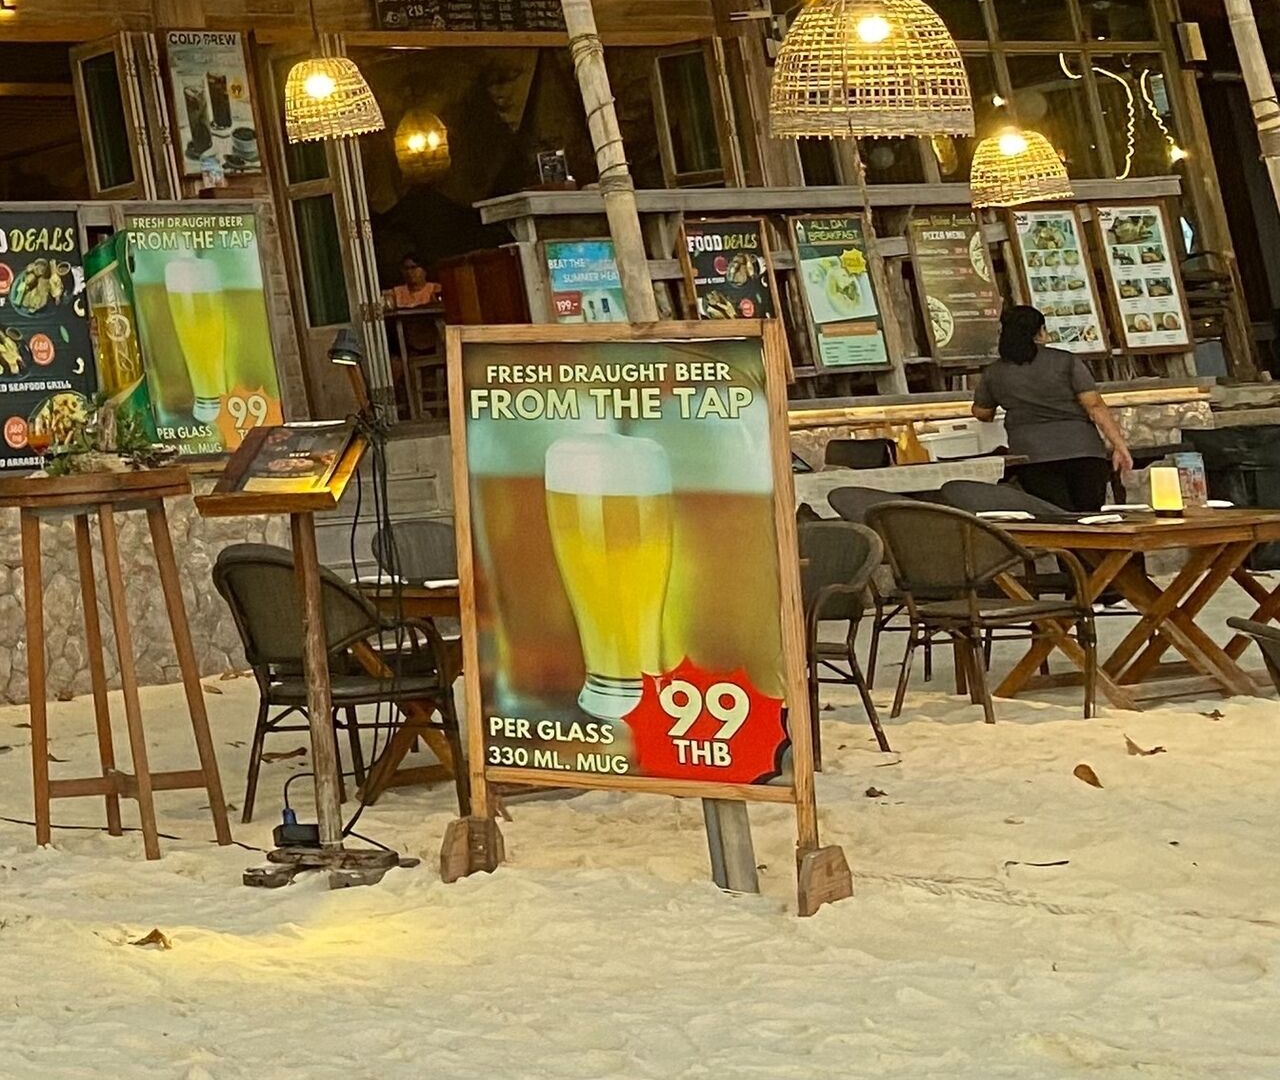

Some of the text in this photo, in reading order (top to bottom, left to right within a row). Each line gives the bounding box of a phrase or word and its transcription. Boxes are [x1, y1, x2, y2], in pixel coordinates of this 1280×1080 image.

[169, 33, 237, 46] COLD BREW
[132, 216, 243, 228] FRESH DRAUGHT BEER
[9, 227, 75, 252] DEALS
[127, 230, 255, 251] FROM THE TAP
[687, 234, 757, 252] FOOD DEALS
[808, 230, 858, 241] BREAKFAST
[548, 258, 567, 269] BEAT
[562, 272, 599, 283] SUMMER
[486, 363, 731, 384] FRESH DRAUGHT BEER
[8, 382, 45, 392] SEAFOOD
[46, 380, 72, 390] GRILL
[228, 395, 268, 428] 99
[470, 387, 754, 420] FROM THE TAP
[157, 425, 213, 440] PER GLASS
[199, 442, 223, 453] MUG
[659, 678, 751, 740] 99
[489, 717, 615, 745] PER GLASS
[488, 746, 629, 775] 330 ML. MUG
[672, 739, 733, 768] THB
